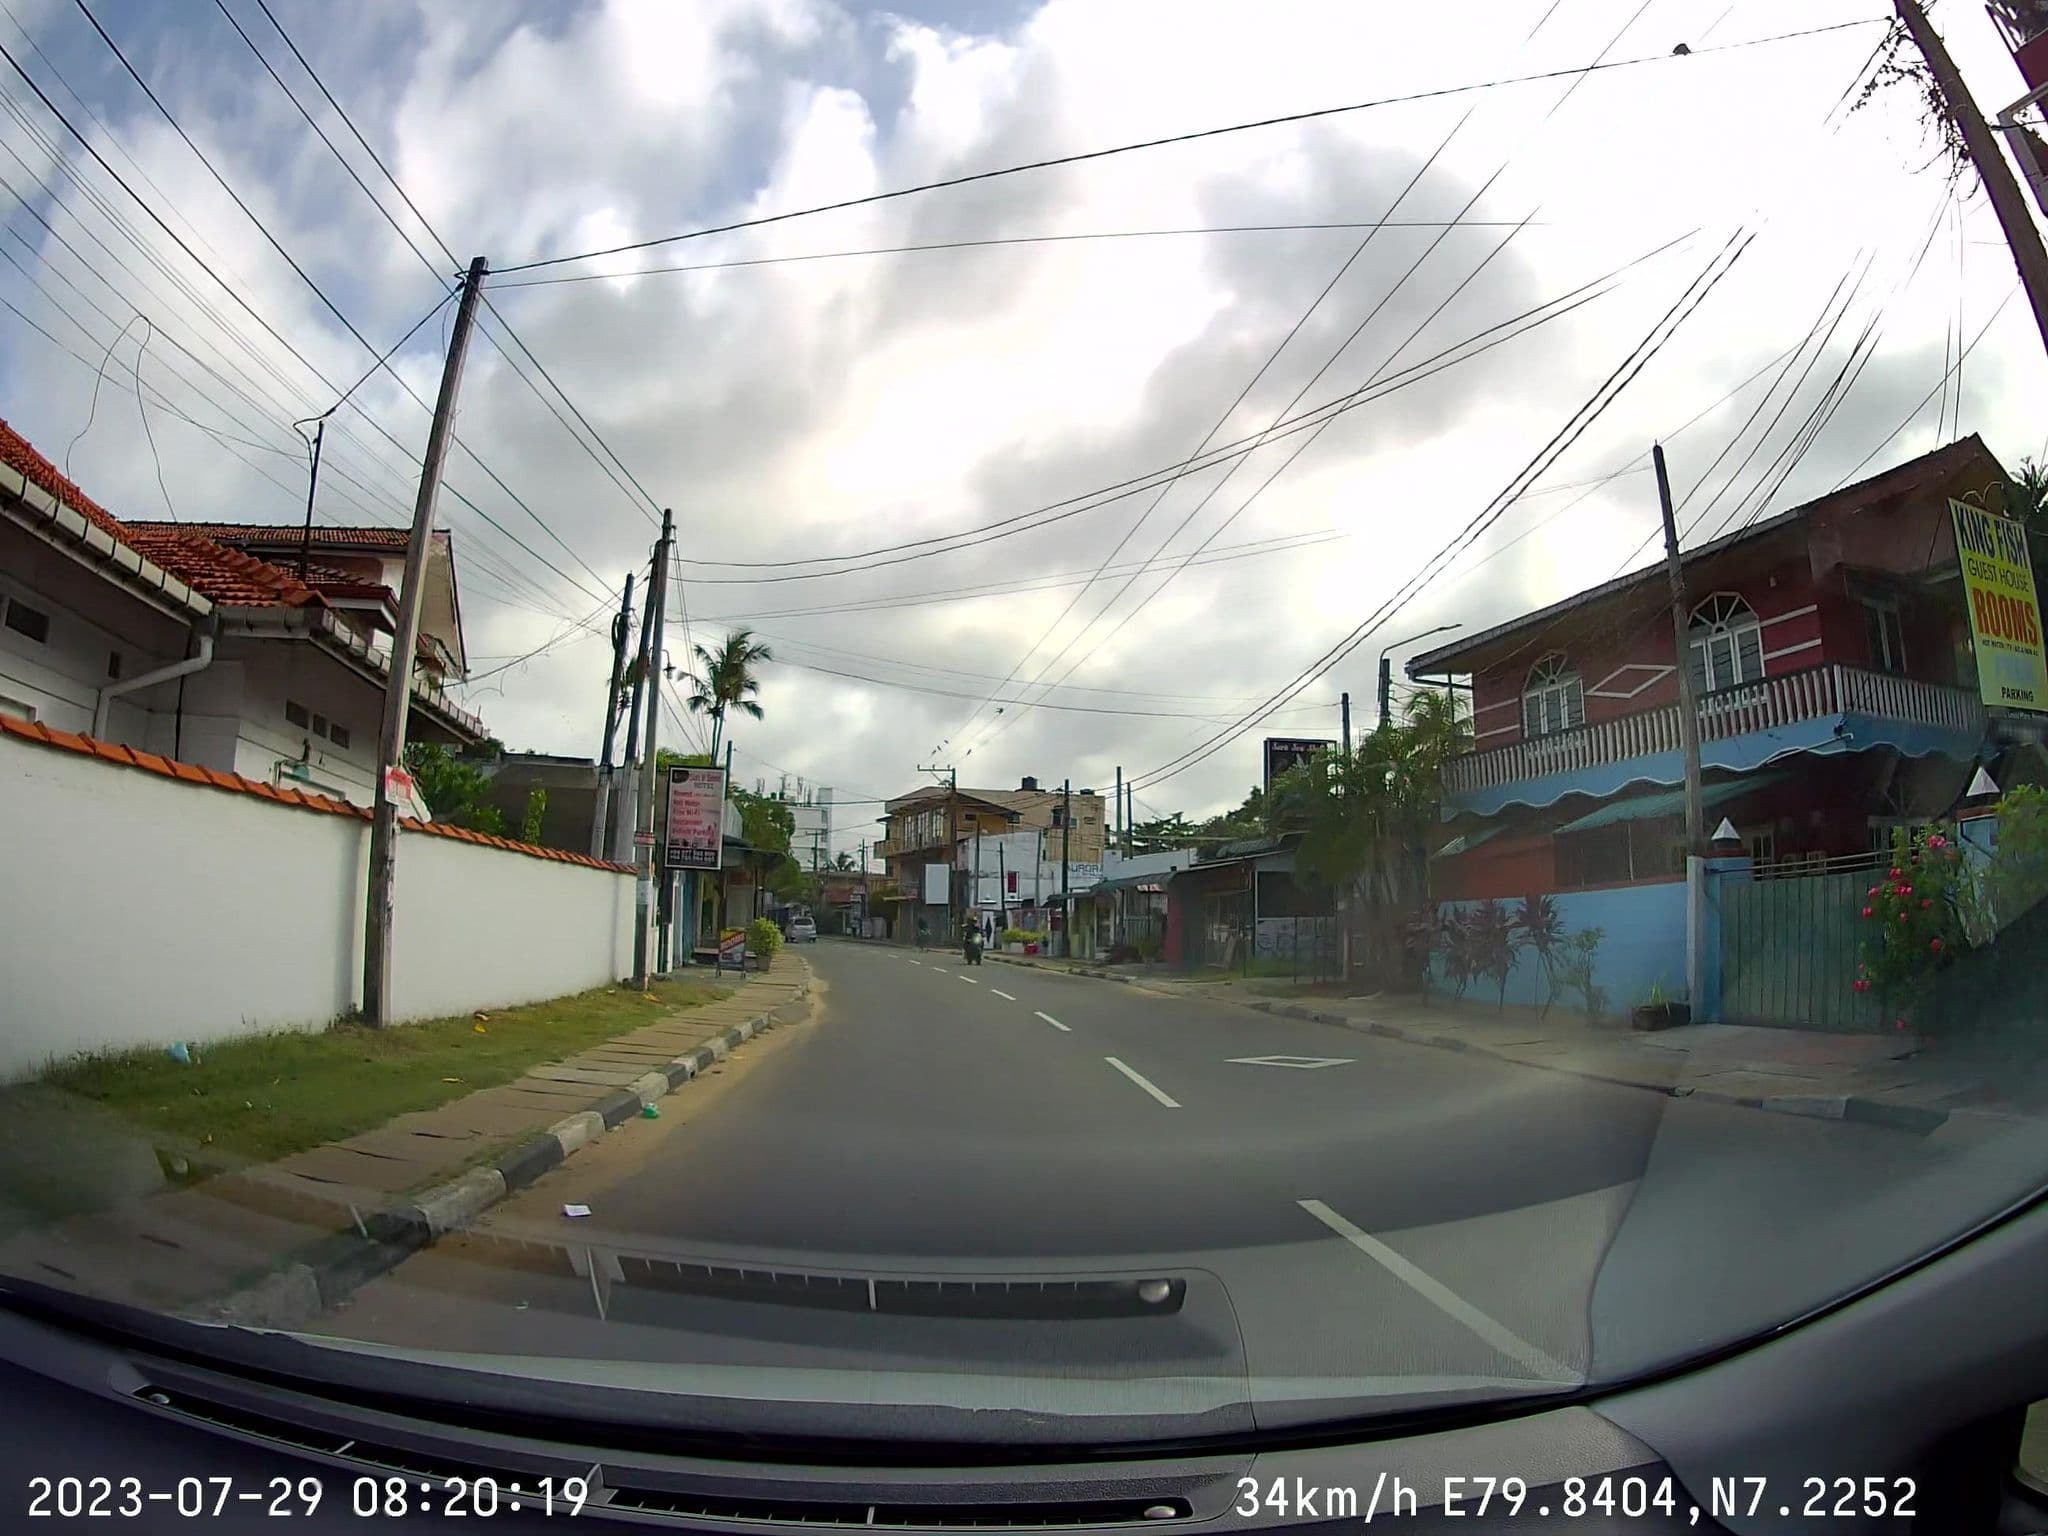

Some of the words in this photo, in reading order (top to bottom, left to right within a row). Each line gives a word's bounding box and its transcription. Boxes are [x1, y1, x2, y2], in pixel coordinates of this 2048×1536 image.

[1954, 504, 1995, 559] KING
[1994, 518, 2028, 569] FISH
[1967, 557, 1998, 582] GUEST
[1999, 567, 2030, 593] HOUSE
[1973, 587, 2039, 647] ROOMS
[2001, 686, 2034, 702] PARKING
